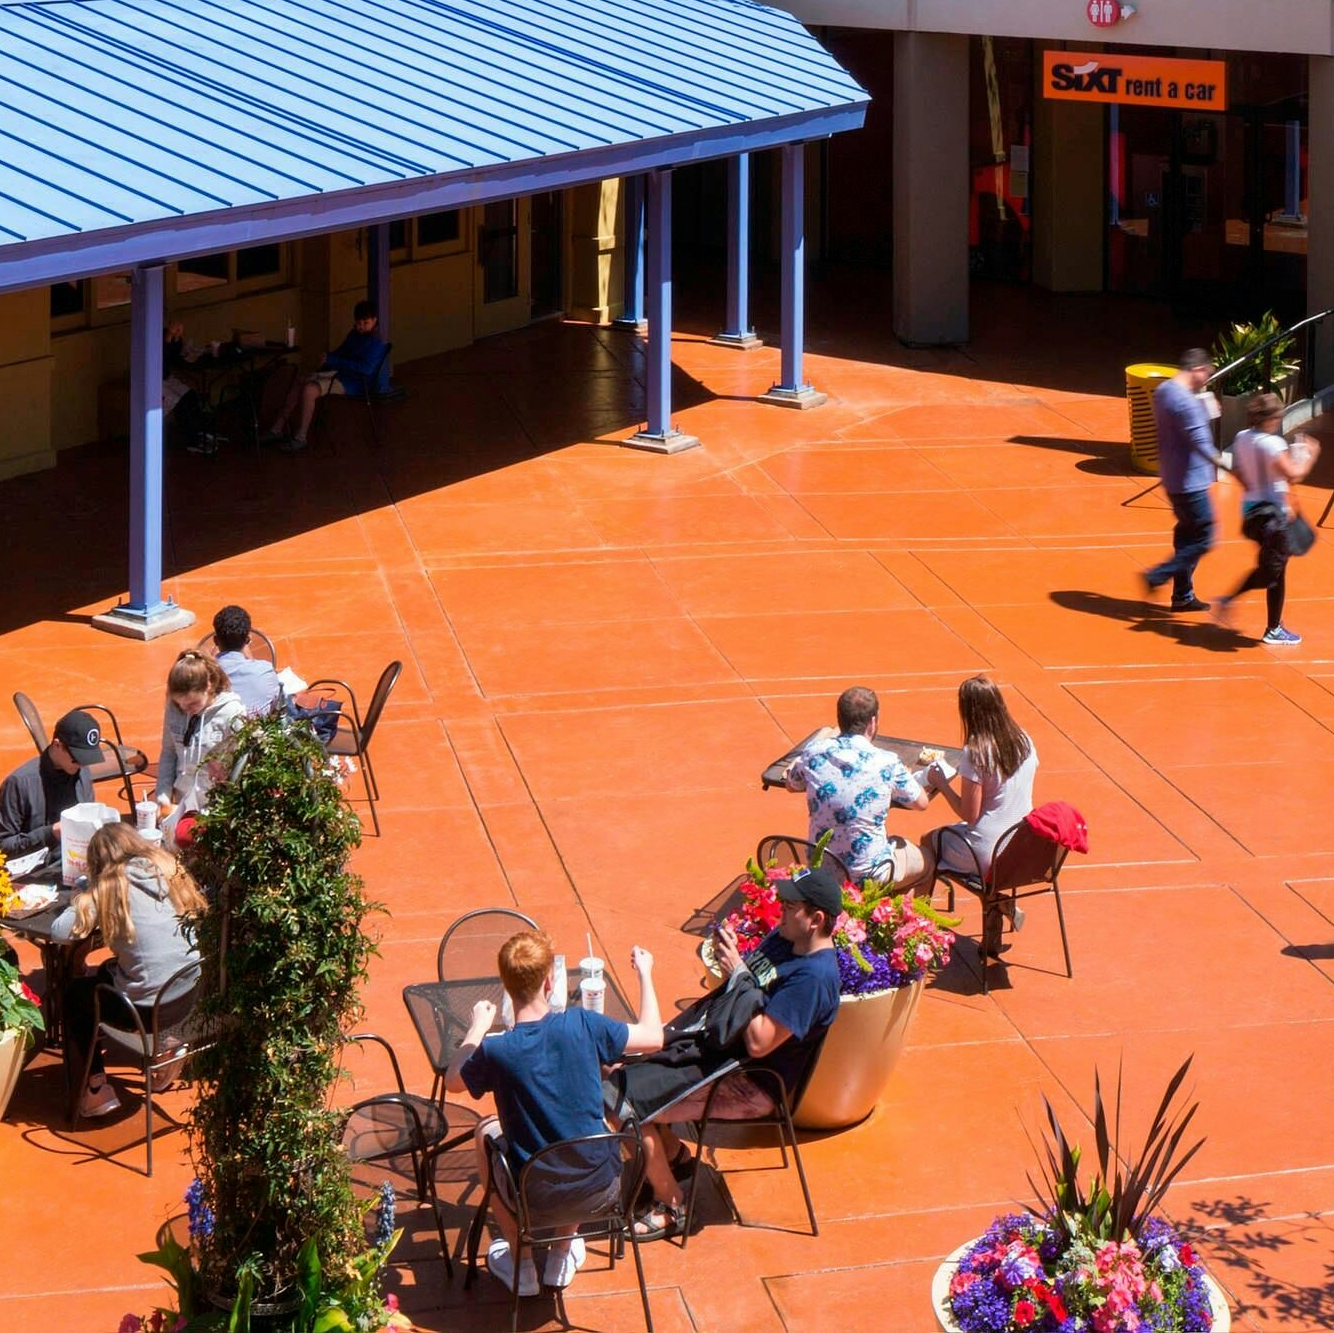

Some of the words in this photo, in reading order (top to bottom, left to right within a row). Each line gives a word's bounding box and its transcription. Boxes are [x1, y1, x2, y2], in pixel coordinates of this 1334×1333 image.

[1125, 77, 1163, 98] rent
[1168, 81, 1179, 99] a
[1184, 82, 1216, 101] car
